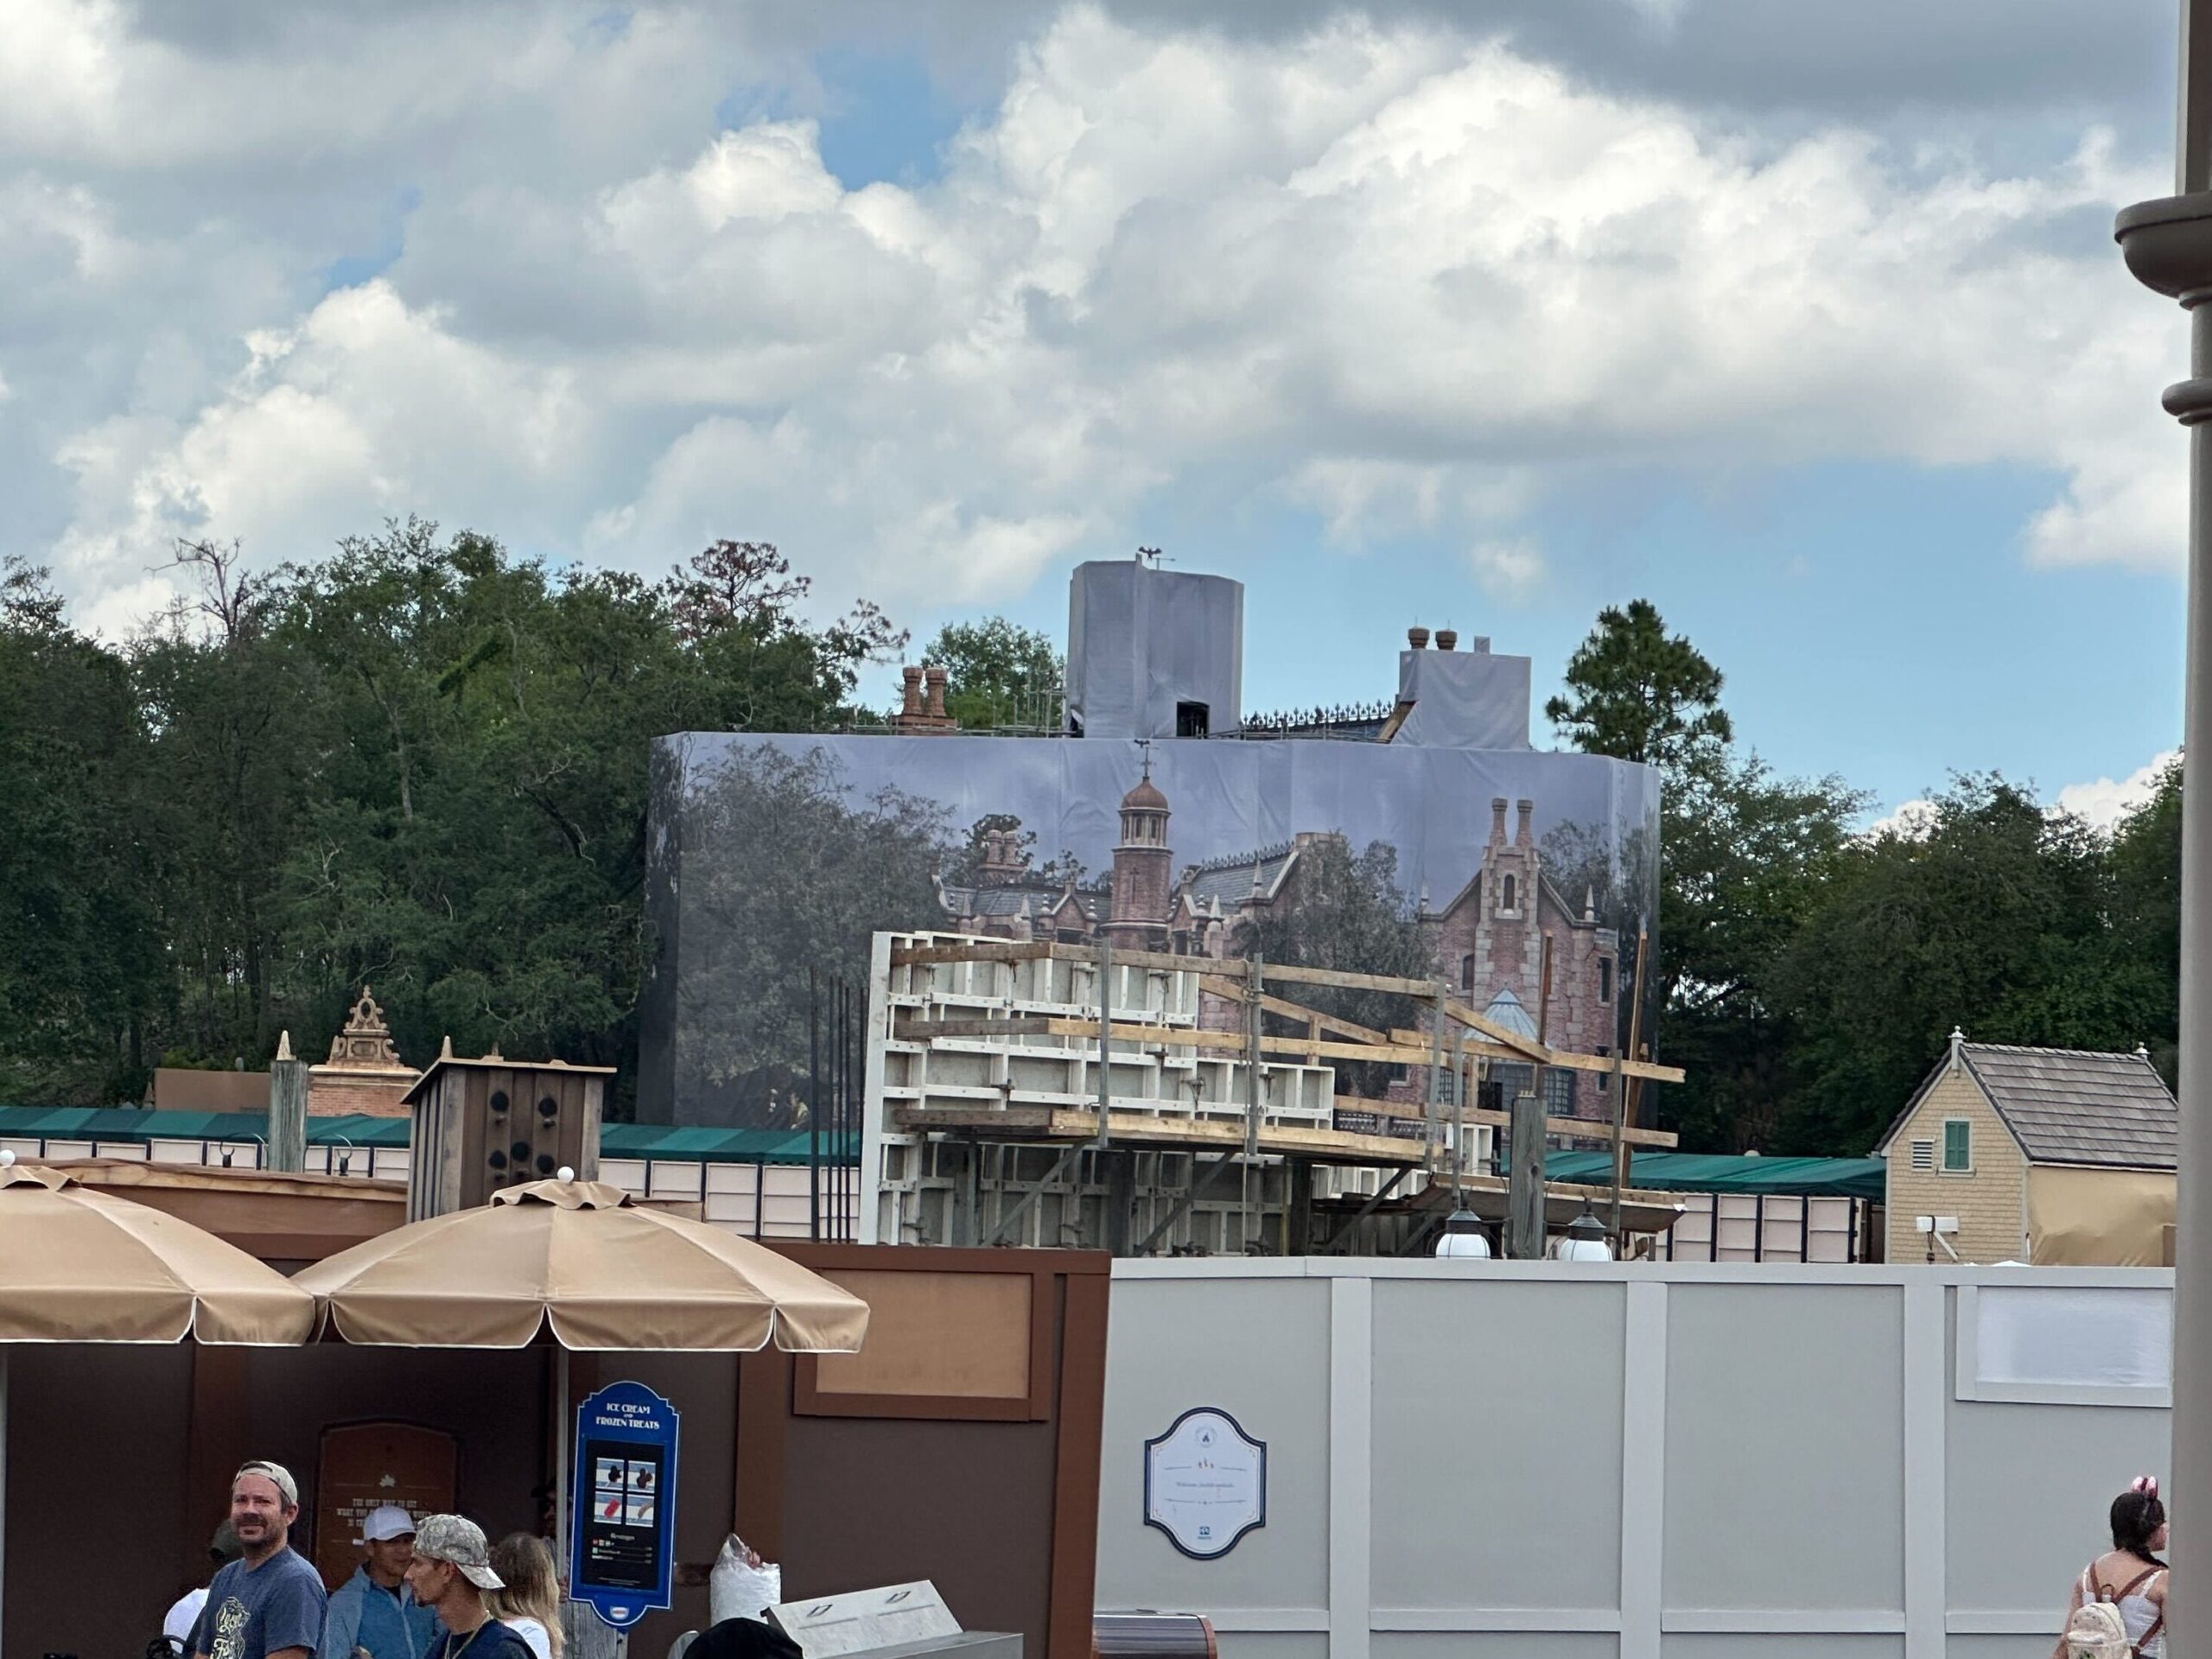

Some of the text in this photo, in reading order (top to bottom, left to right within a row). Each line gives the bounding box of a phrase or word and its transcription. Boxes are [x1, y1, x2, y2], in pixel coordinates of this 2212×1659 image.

[607, 1403, 651, 1414] ICE CREAM
[595, 1416, 660, 1430] FROZEN TREATS
[353, 1498, 364, 1507] THE
